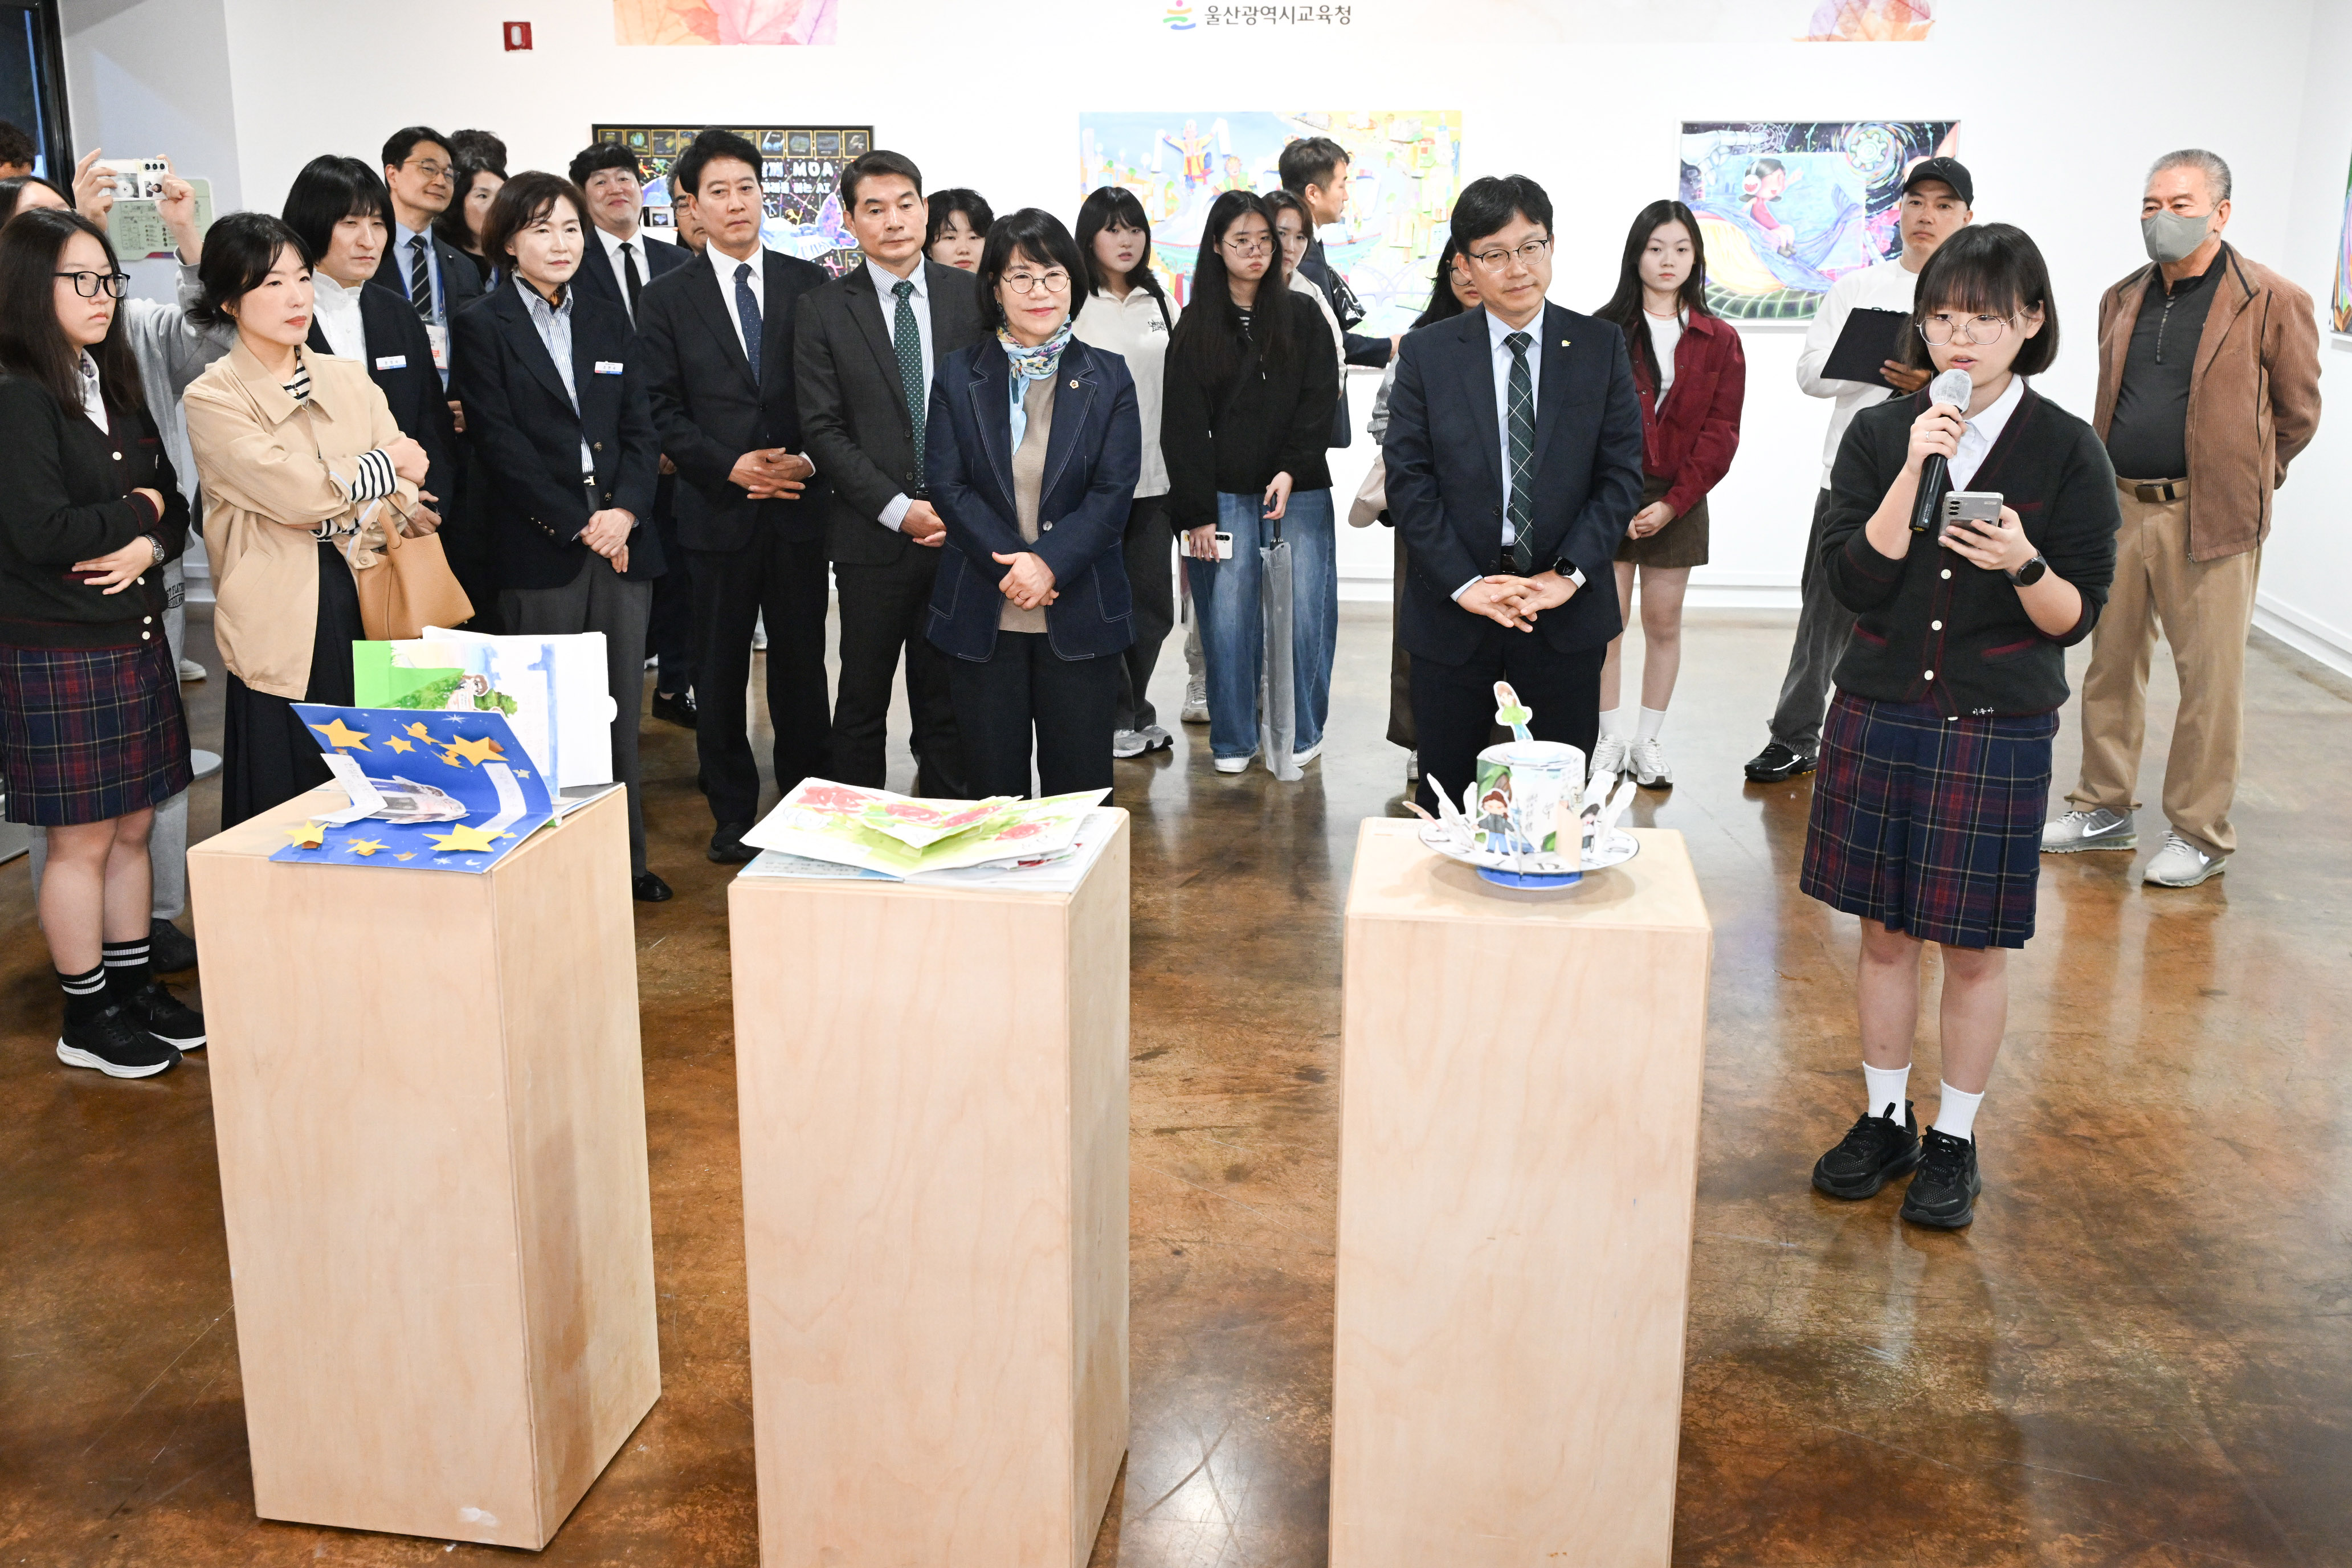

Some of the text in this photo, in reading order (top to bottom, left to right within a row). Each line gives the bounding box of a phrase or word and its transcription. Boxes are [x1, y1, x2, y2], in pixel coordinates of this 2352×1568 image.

[1204, 5, 1351, 26] 울산광역시교육청
[793, 161, 834, 177] MOA
[816, 182, 831, 193] AI
